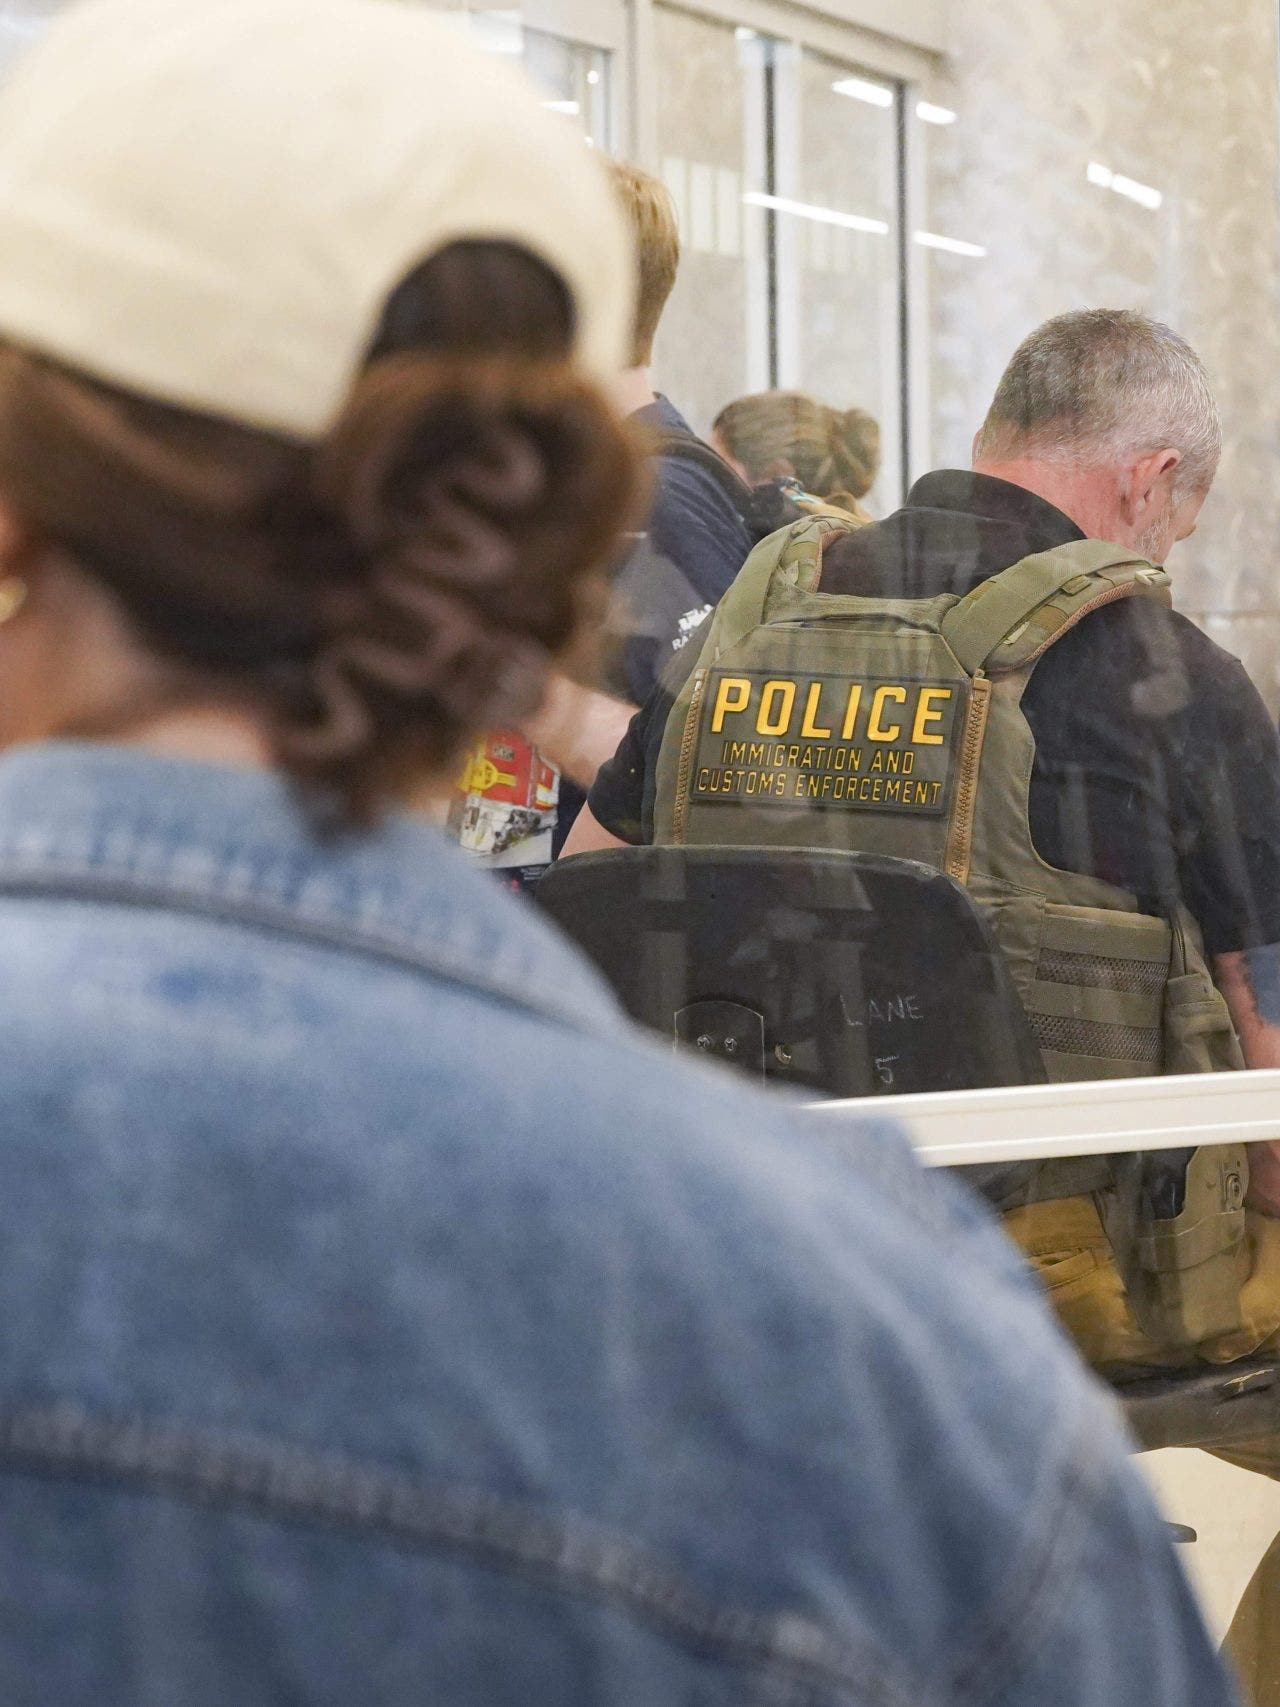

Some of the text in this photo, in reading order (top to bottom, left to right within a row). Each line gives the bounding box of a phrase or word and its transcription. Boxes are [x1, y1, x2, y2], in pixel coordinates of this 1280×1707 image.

[711, 678, 952, 745] POLICE
[722, 741, 914, 775] IMMIGRATION AND
[698, 768, 942, 805] CUSTOMS ENFORCEMENT
[840, 994, 924, 1026] LANE
[875, 1054, 900, 1084] 5
